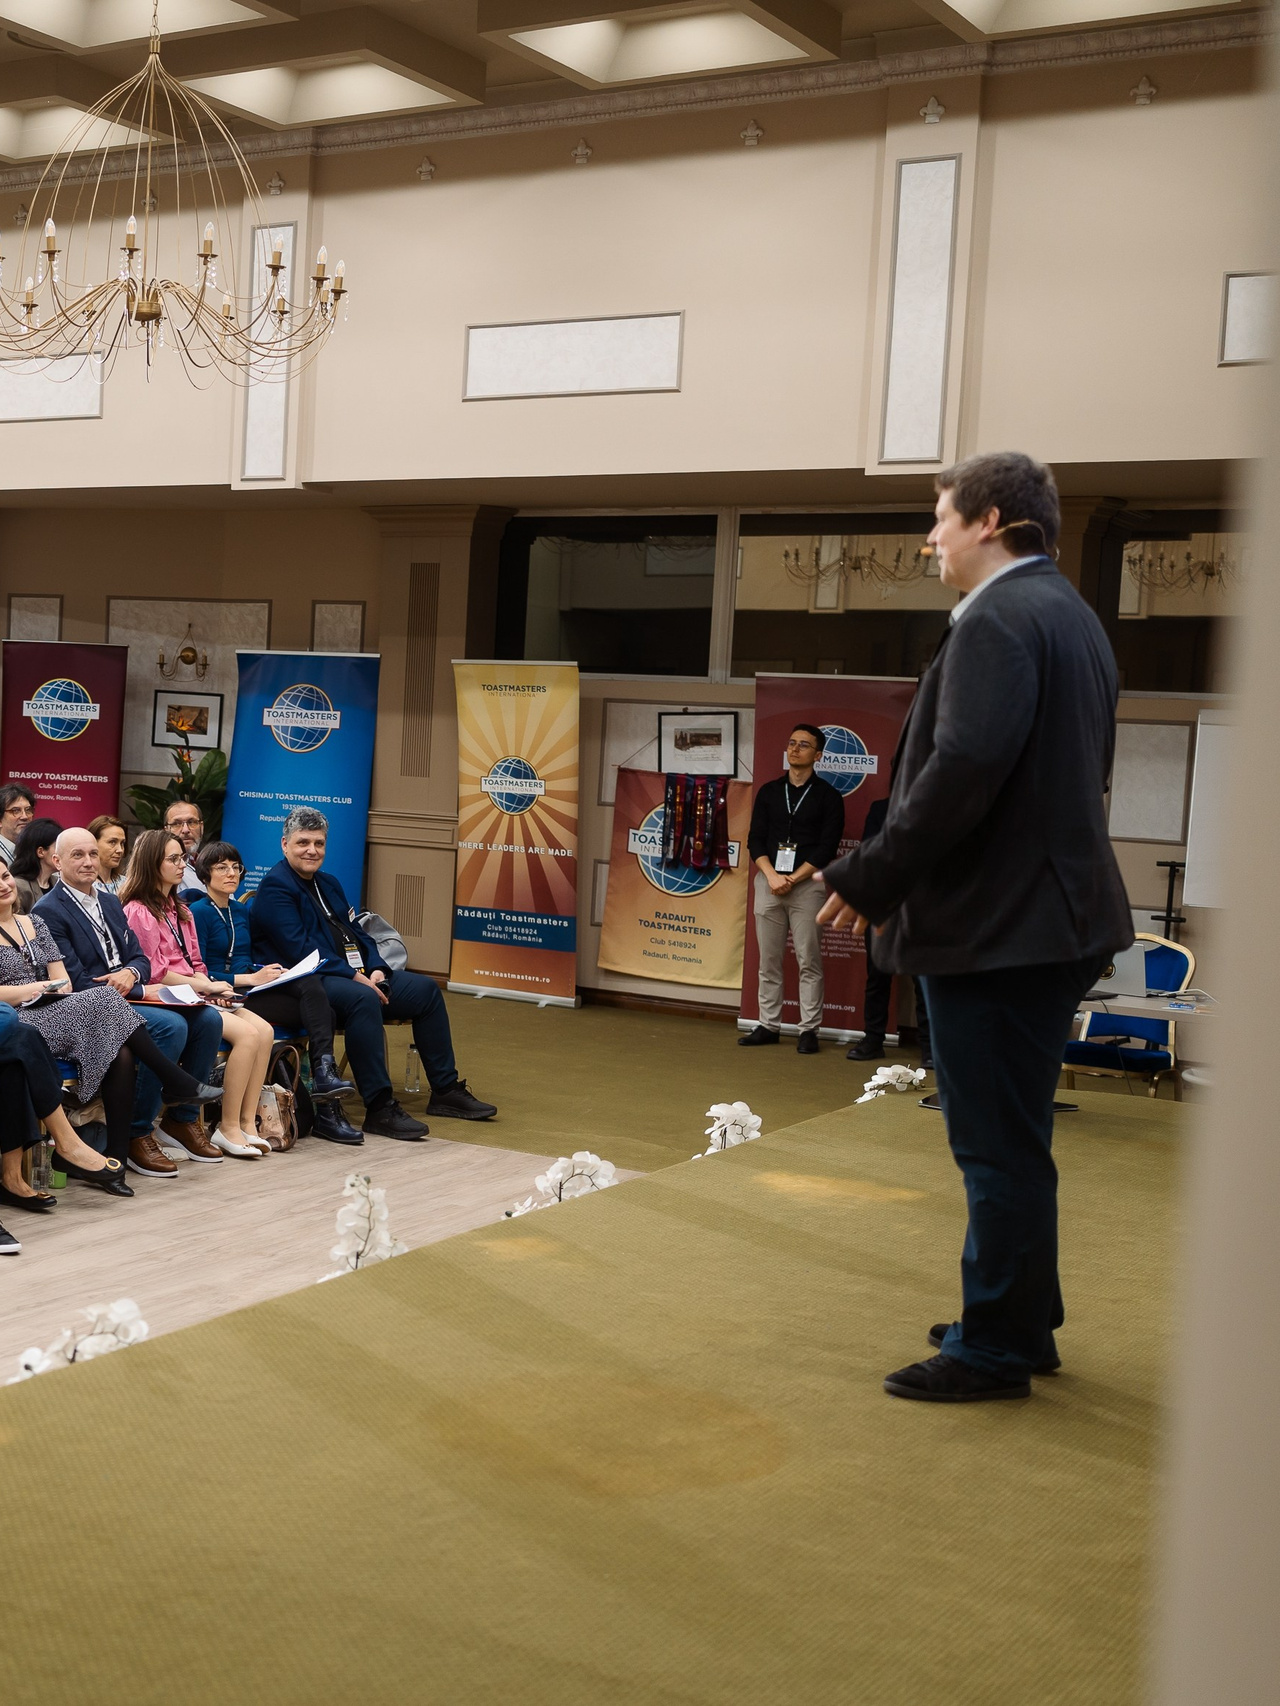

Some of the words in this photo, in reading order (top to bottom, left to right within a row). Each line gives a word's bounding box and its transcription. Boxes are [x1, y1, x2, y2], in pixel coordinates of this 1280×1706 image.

[482, 684, 547, 693] TOASTMASTERS
[26, 703, 97, 713] TOASTMASTERS
[33, 710, 89, 718] INTERNATIONAL
[266, 710, 338, 721] TOASTMASTERS
[9, 771, 43, 780] BRASOV
[45, 773, 109, 783] TOASTMASTERS
[483, 779, 543, 788] TOASTMASTERS
[56, 792, 82, 802] Romania
[239, 791, 274, 799] CHISINAU
[275, 793, 332, 803] TOASTMASTERS
[332, 796, 352, 804] CLUB
[487, 843, 526, 853] LEADERS
[528, 846, 545, 855] ARE
[548, 848, 573, 857] MADE
[500, 913, 569, 927] Toastmasters
[654, 911, 696, 924] RADAUTI
[487, 924, 503, 932] Club
[504, 926, 538, 935] 05418924
[638, 919, 712, 937] TOASTMASTERS
[650, 937, 666, 946] Club
[667, 939, 697, 950] 5418924
[642, 949, 671, 960] Radauti,
[672, 953, 703, 965] Romania
[474, 968, 551, 983] www.toastmasters.ro
